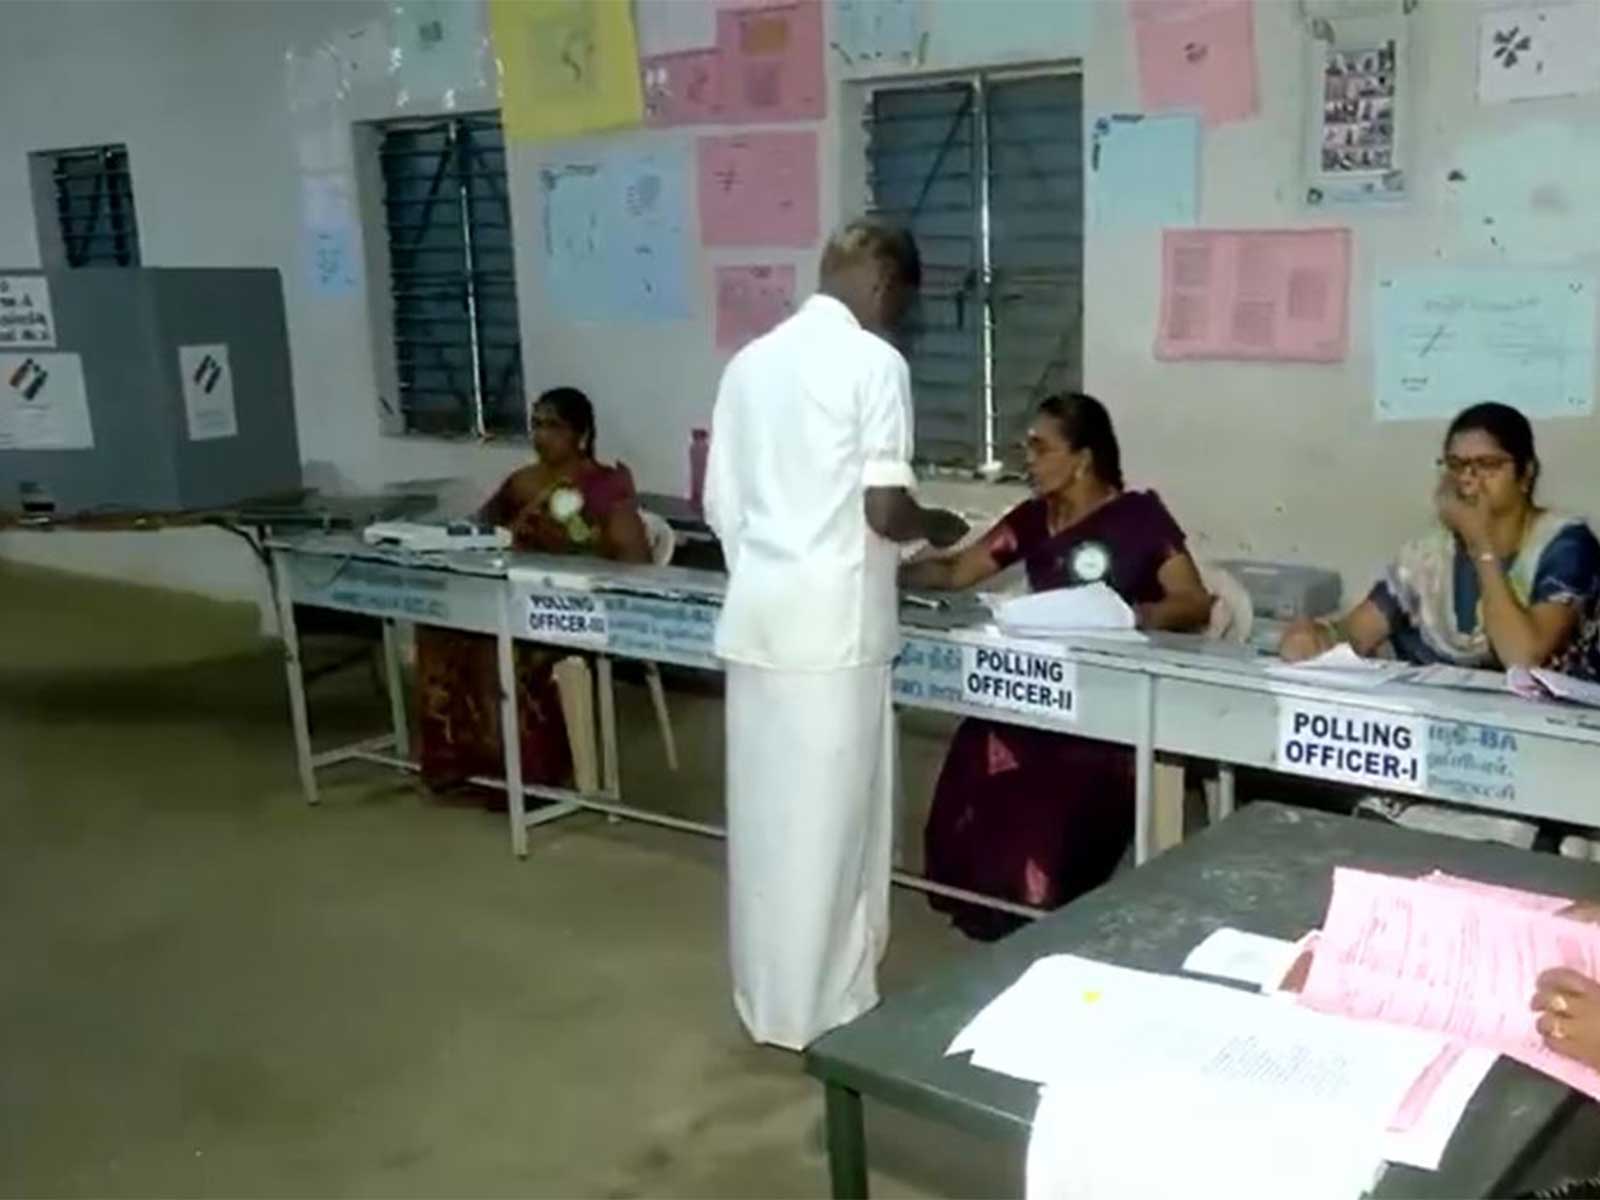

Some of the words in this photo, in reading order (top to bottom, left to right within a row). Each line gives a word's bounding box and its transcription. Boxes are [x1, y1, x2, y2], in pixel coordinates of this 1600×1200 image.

[530, 595, 595, 612] POLLING
[976, 649, 1063, 682] POLLING
[967, 673, 1072, 710] OFFICER-II
[1294, 712, 1412, 750] POLLING
[1285, 740, 1418, 781] OFFICER-I
